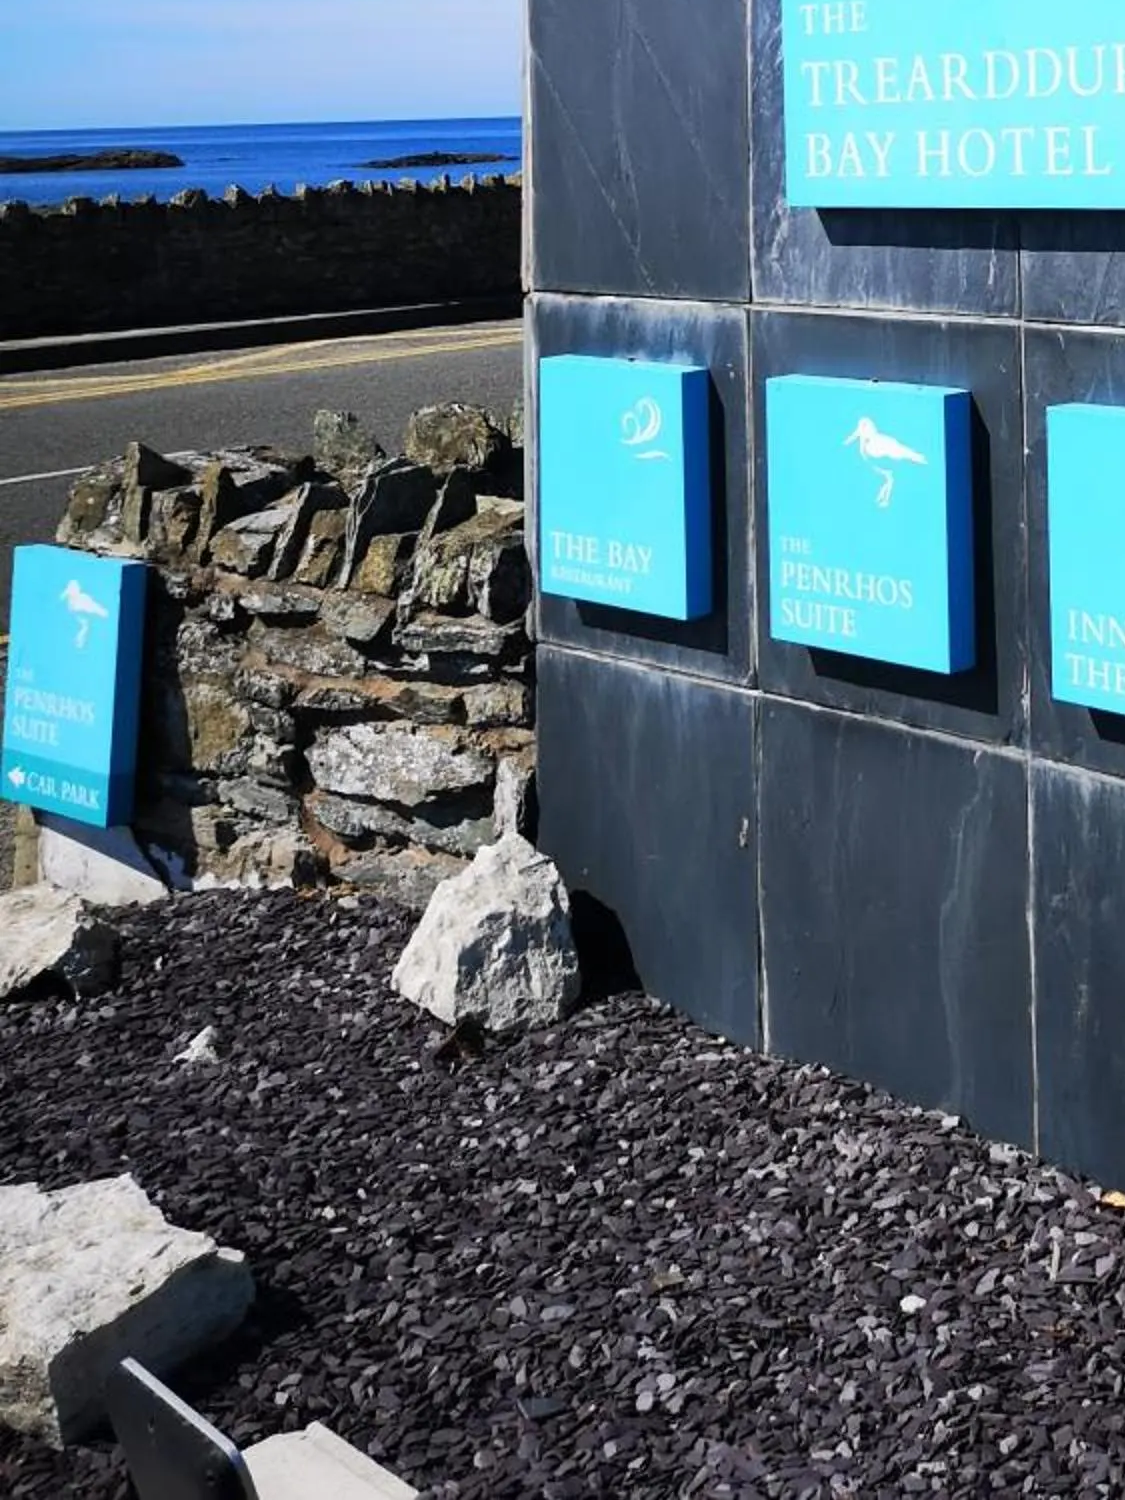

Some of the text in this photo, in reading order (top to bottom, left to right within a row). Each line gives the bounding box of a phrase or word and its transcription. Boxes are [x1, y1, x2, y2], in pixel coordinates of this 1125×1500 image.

[800, 1, 868, 36] THE
[805, 124, 1113, 178] BAY HOTEL
[551, 531, 653, 575] THE BAY
[780, 535, 812, 555] THE
[780, 560, 914, 609] PENRHOS
[780, 598, 857, 637] SUITE
[12, 715, 60, 747] SUITE
[26, 771, 100, 810] CAR PARK
